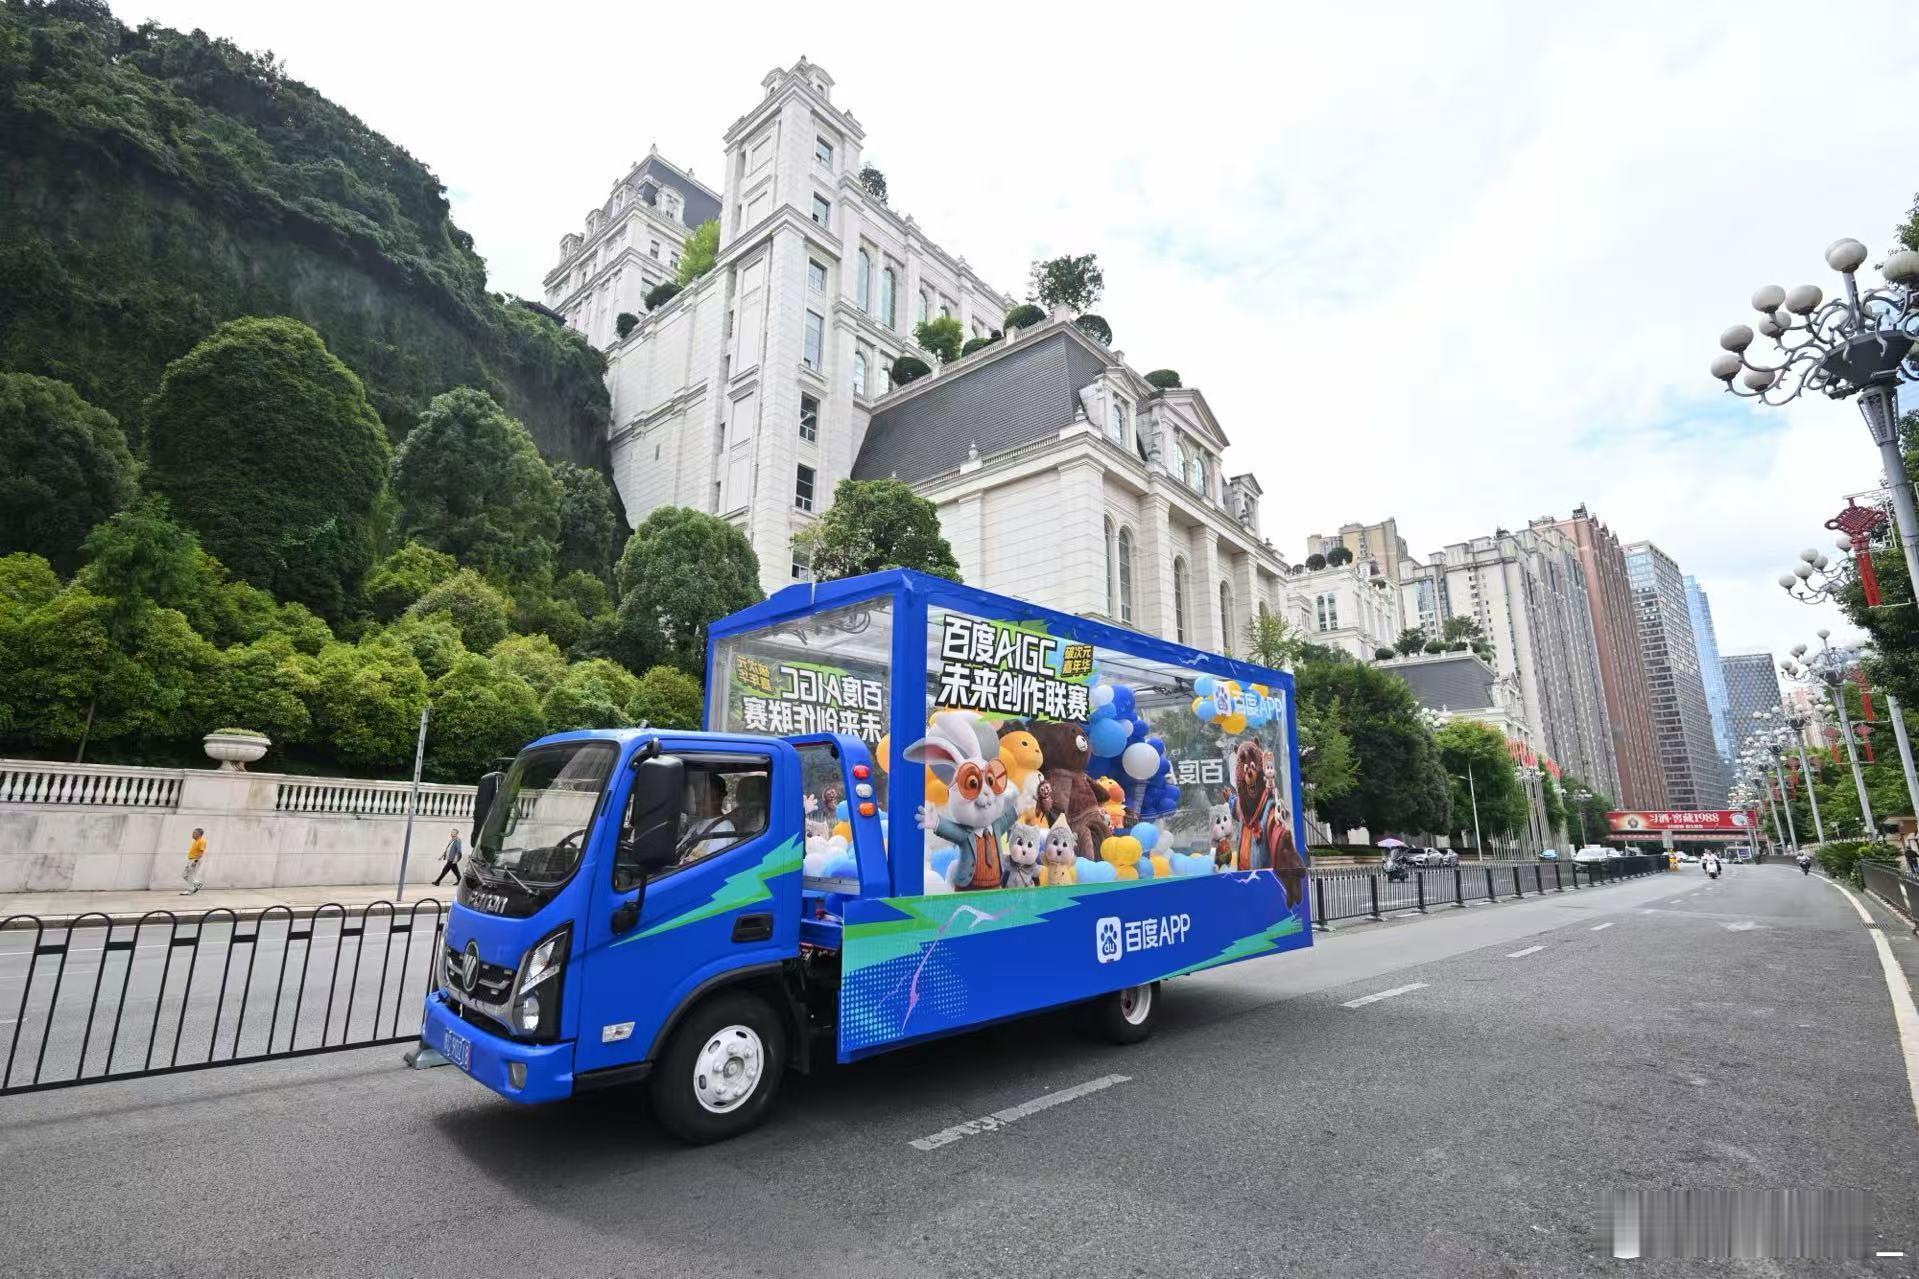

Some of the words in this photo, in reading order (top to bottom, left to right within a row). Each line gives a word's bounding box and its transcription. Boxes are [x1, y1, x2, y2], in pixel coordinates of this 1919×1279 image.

[942, 615, 1057, 676] 百度AIGC
[938, 663, 1088, 721] 未来创作联赛
[1124, 913, 1191, 952] 百度APP
